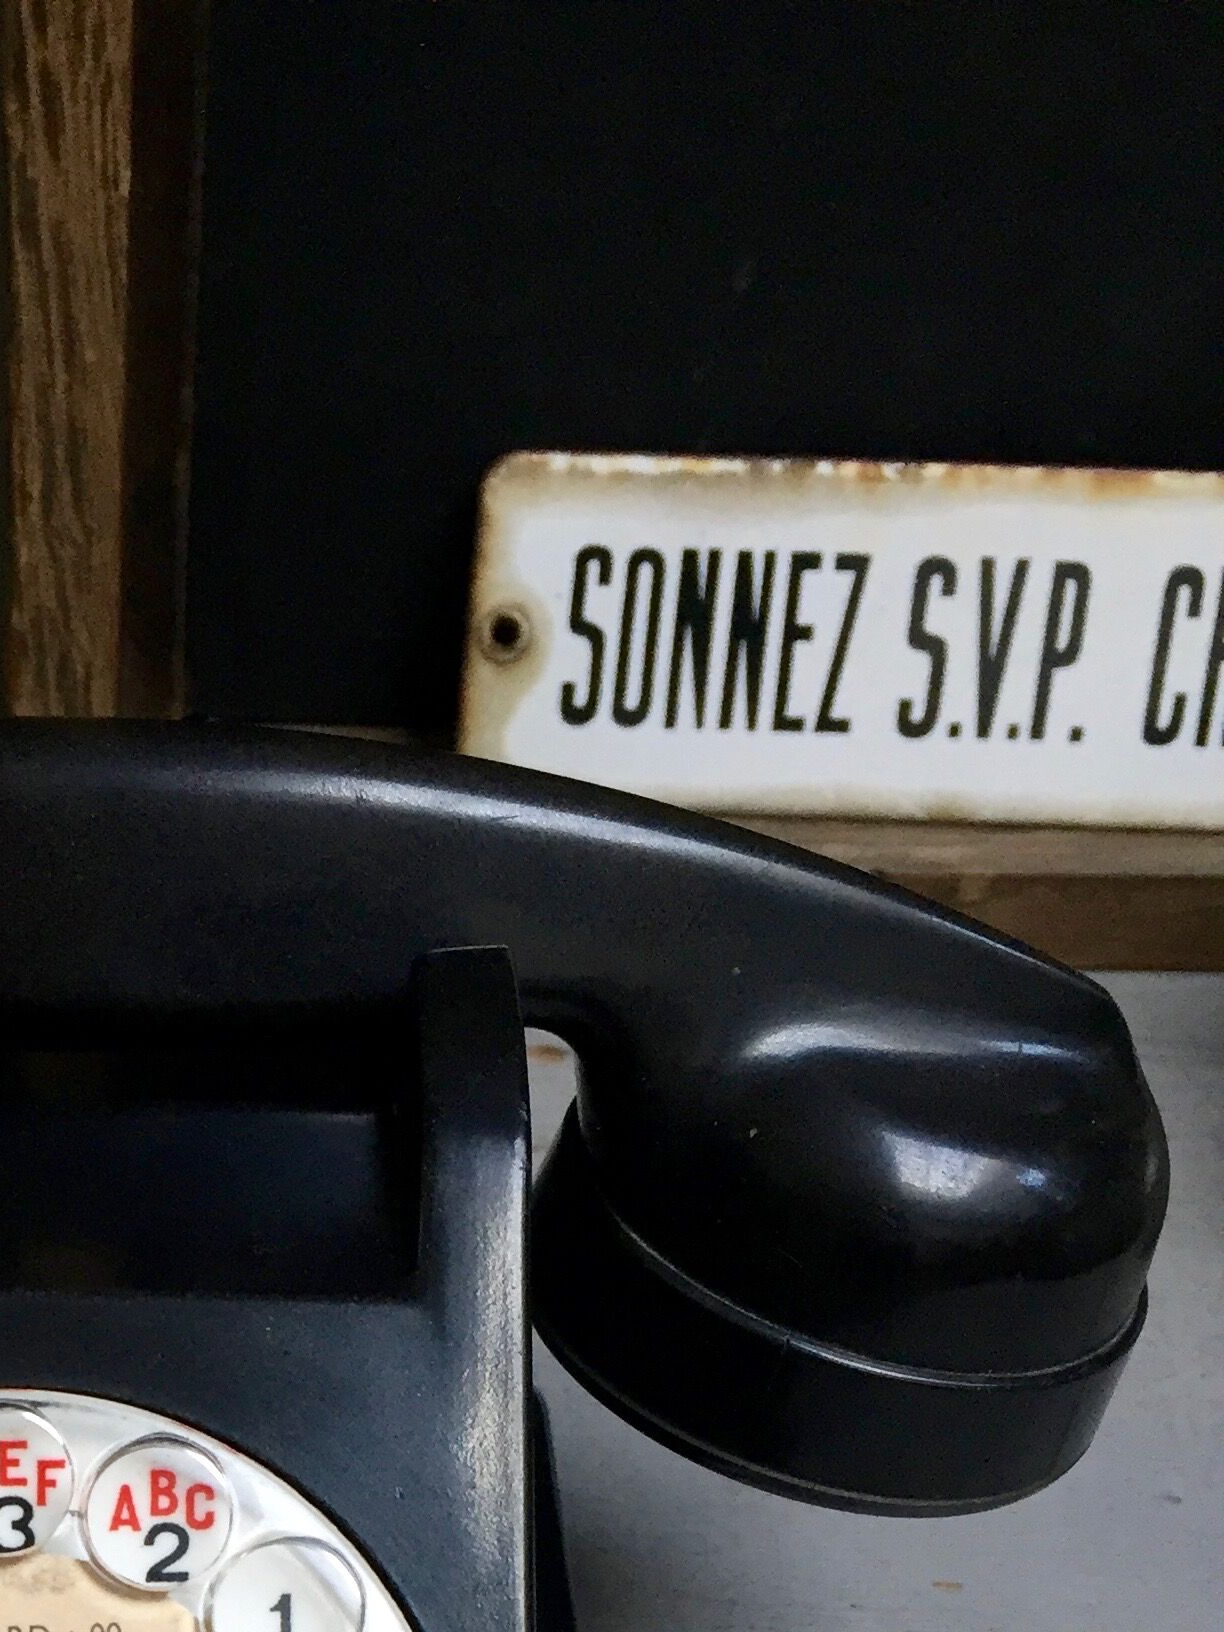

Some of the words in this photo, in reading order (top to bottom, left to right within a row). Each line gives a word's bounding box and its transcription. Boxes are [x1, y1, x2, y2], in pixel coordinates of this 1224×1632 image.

[560, 544, 871, 734] SONNEZ
[896, 555, 1093, 742] S.V.P.
[109, 1467, 216, 1532] ABC
[143, 1522, 190, 1583] 2
